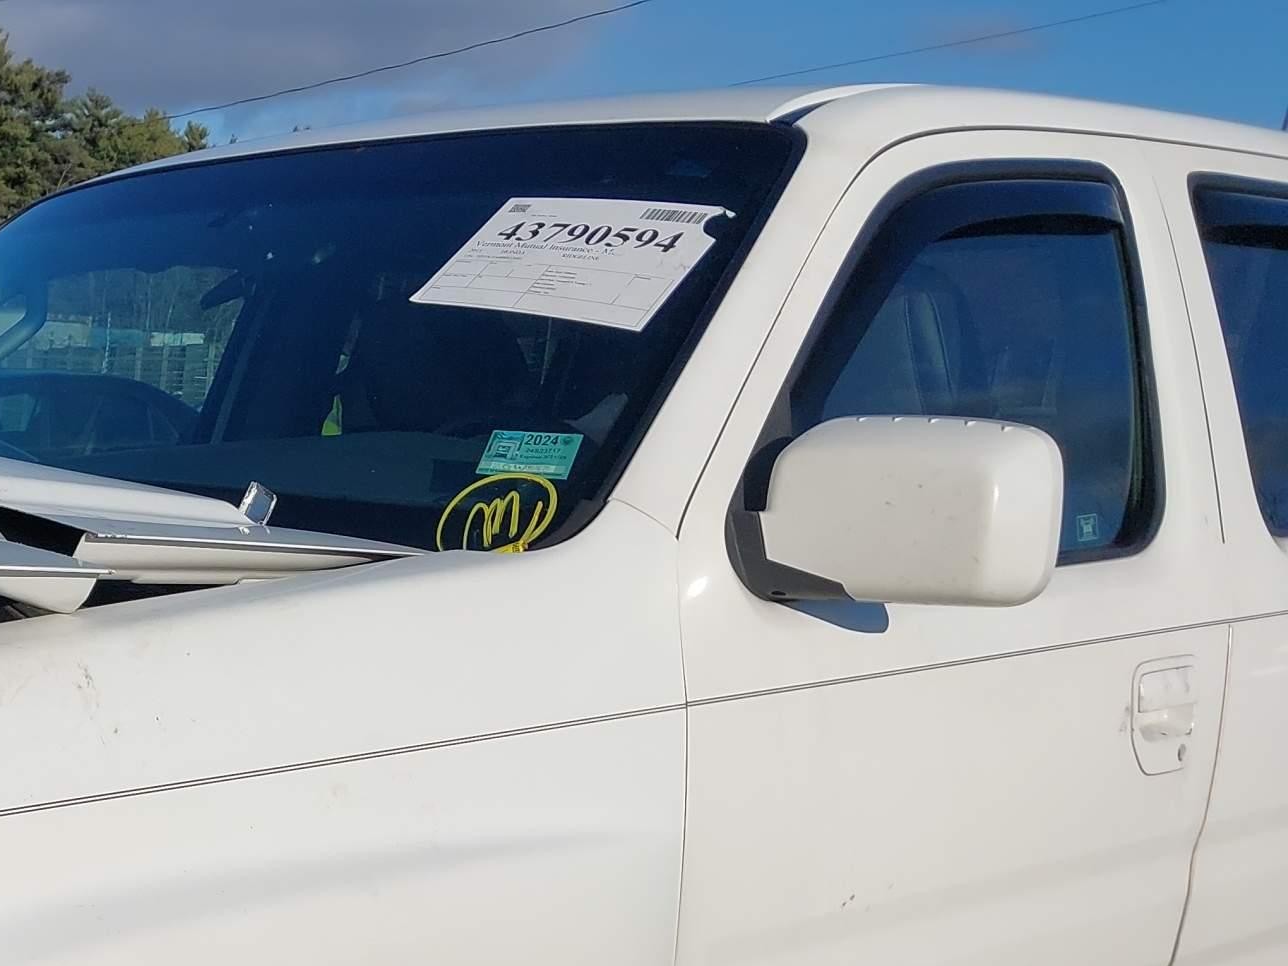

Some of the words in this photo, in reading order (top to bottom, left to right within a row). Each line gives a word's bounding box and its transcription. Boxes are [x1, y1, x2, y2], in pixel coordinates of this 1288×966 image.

[497, 221, 684, 253] 43790594
[476, 240, 513, 249] Vermont
[514, 241, 546, 250] Mutual
[548, 243, 593, 254] Insurance
[523, 433, 560, 446] 2024
